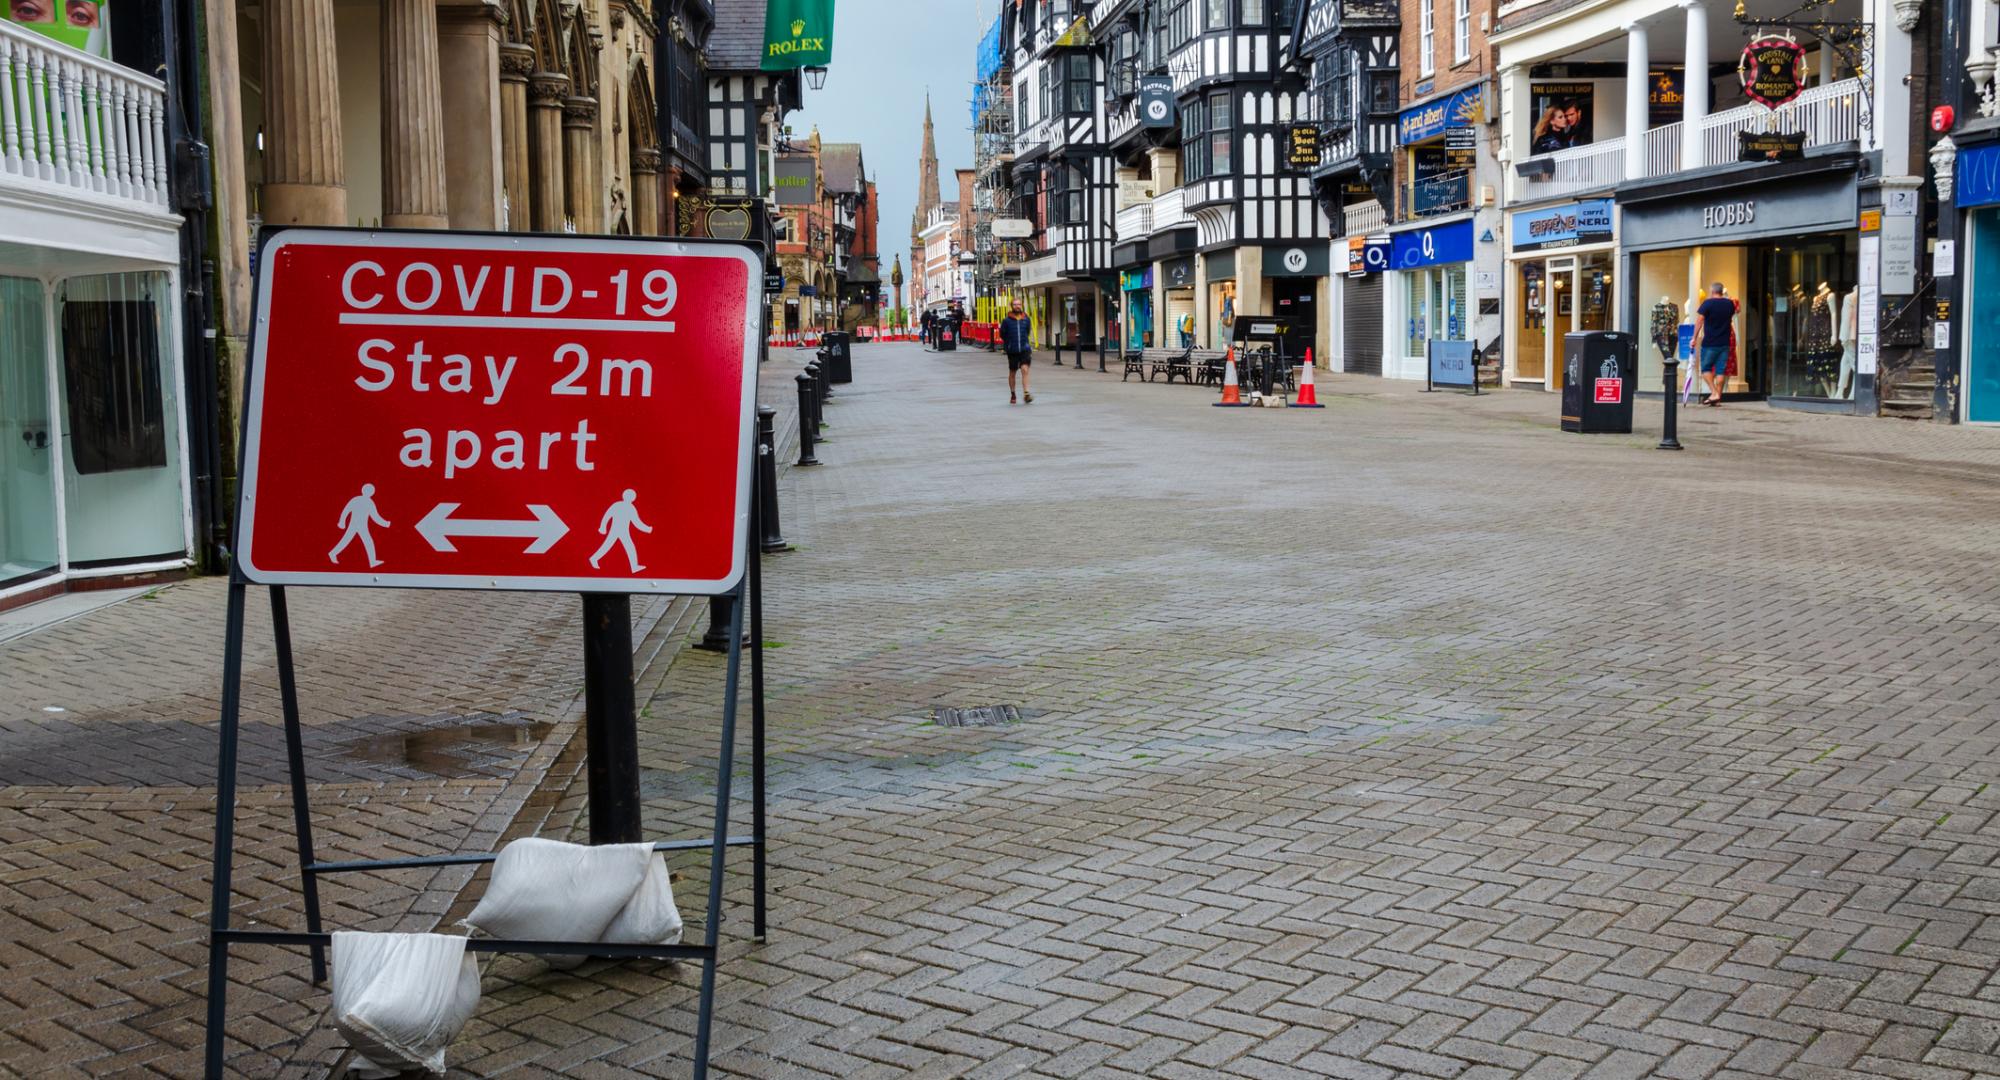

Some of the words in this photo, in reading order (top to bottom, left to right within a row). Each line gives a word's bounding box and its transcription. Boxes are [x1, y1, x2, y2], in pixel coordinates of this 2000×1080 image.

[769, 37, 824, 57] ROLEX
[1143, 82, 1171, 92] FATFACE
[1532, 86, 1545, 94] THE
[1546, 86, 1574, 94] LEATHER
[1575, 86, 1592, 94] SHOP
[1424, 105, 1444, 127] albert
[1578, 216, 1610, 227] NERO
[1703, 201, 1755, 228] HOBBS
[341, 260, 678, 317] COVID-19
[1860, 342, 1875, 354] ZEN
[355, 338, 517, 406] Stay
[550, 343, 653, 397] 2m
[1441, 358, 1464, 371] NERO
[399, 419, 597, 479] apart
